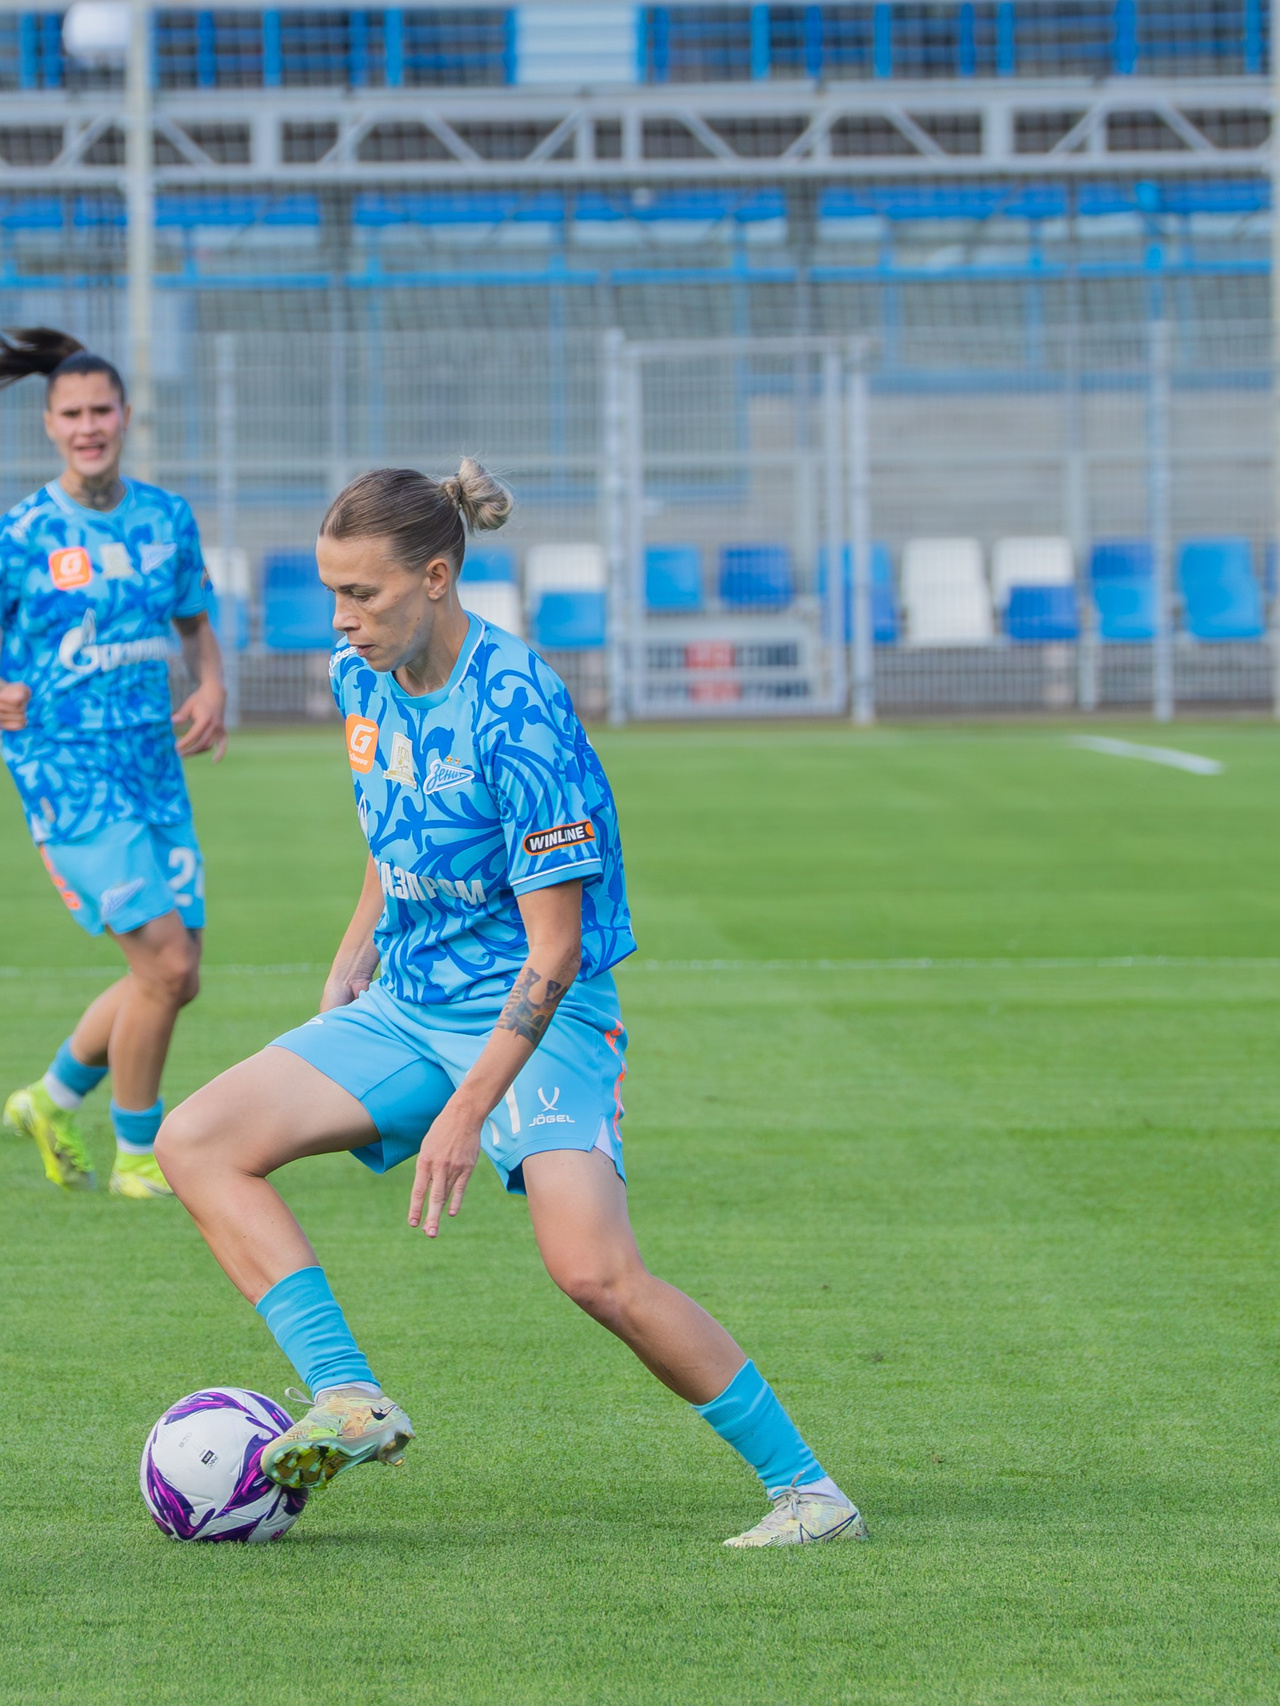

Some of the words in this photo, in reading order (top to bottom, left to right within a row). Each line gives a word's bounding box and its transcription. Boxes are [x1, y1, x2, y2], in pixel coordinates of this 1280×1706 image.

[529, 825, 586, 851] WINLINE
[375, 859, 487, 905] АЗПРОМ
[528, 1114, 576, 1127] JÖGEL
